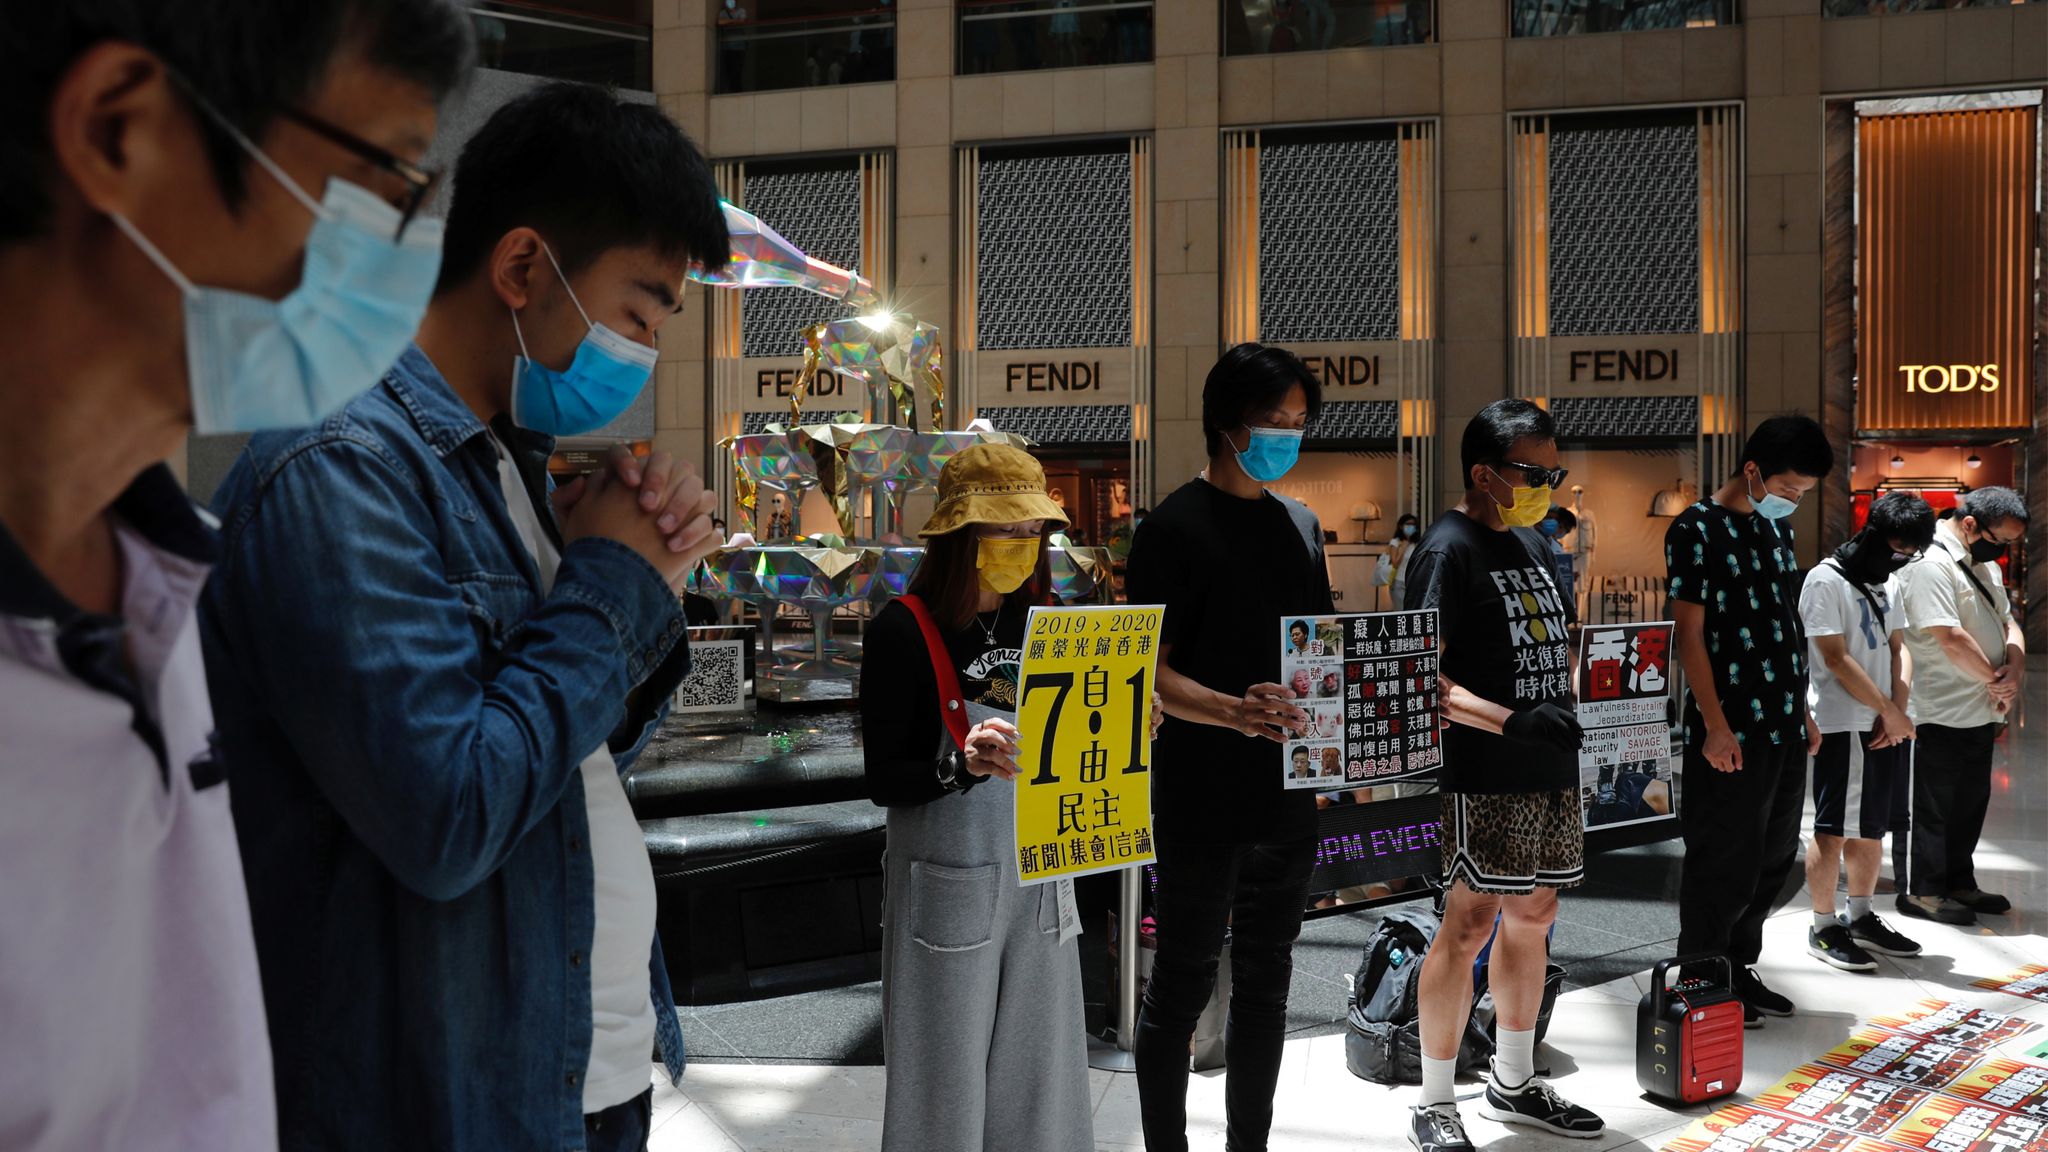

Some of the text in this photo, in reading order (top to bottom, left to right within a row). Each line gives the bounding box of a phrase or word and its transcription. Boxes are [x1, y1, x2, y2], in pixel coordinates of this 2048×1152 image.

[1006, 361, 1100, 392] FENDI
[1300, 355, 1380, 386] ENDI
[1570, 349, 1678, 381] FENDI
[1899, 364, 1999, 393] TOD'S
[1490, 567, 1555, 593] FREE
[1605, 593, 1638, 604] FENDI
[1035, 616, 1087, 635] 2019
[1110, 613, 1157, 632] 2020
[1028, 634, 1152, 660] 願榮光歸香港
[1513, 643, 1569, 673] 光復香
[972, 649, 1022, 675] Kenz
[1515, 671, 1571, 700] 時代革
[1582, 701, 1666, 714] Lawfulness Brutality
[1596, 712, 1657, 725] Jeopardization
[1021, 666, 1148, 785] 7 1
[1620, 723, 1668, 738] NOTORIOUS
[1347, 737, 1401, 758] 剛愎自用
[1582, 737, 1661, 754] security SAVAGE
[1595, 747, 1669, 765] law LEGITIMACY
[1347, 754, 1402, 779] 偽善之最
[1057, 788, 1121, 836] 民主
[1370, 822, 1441, 856] EVER
